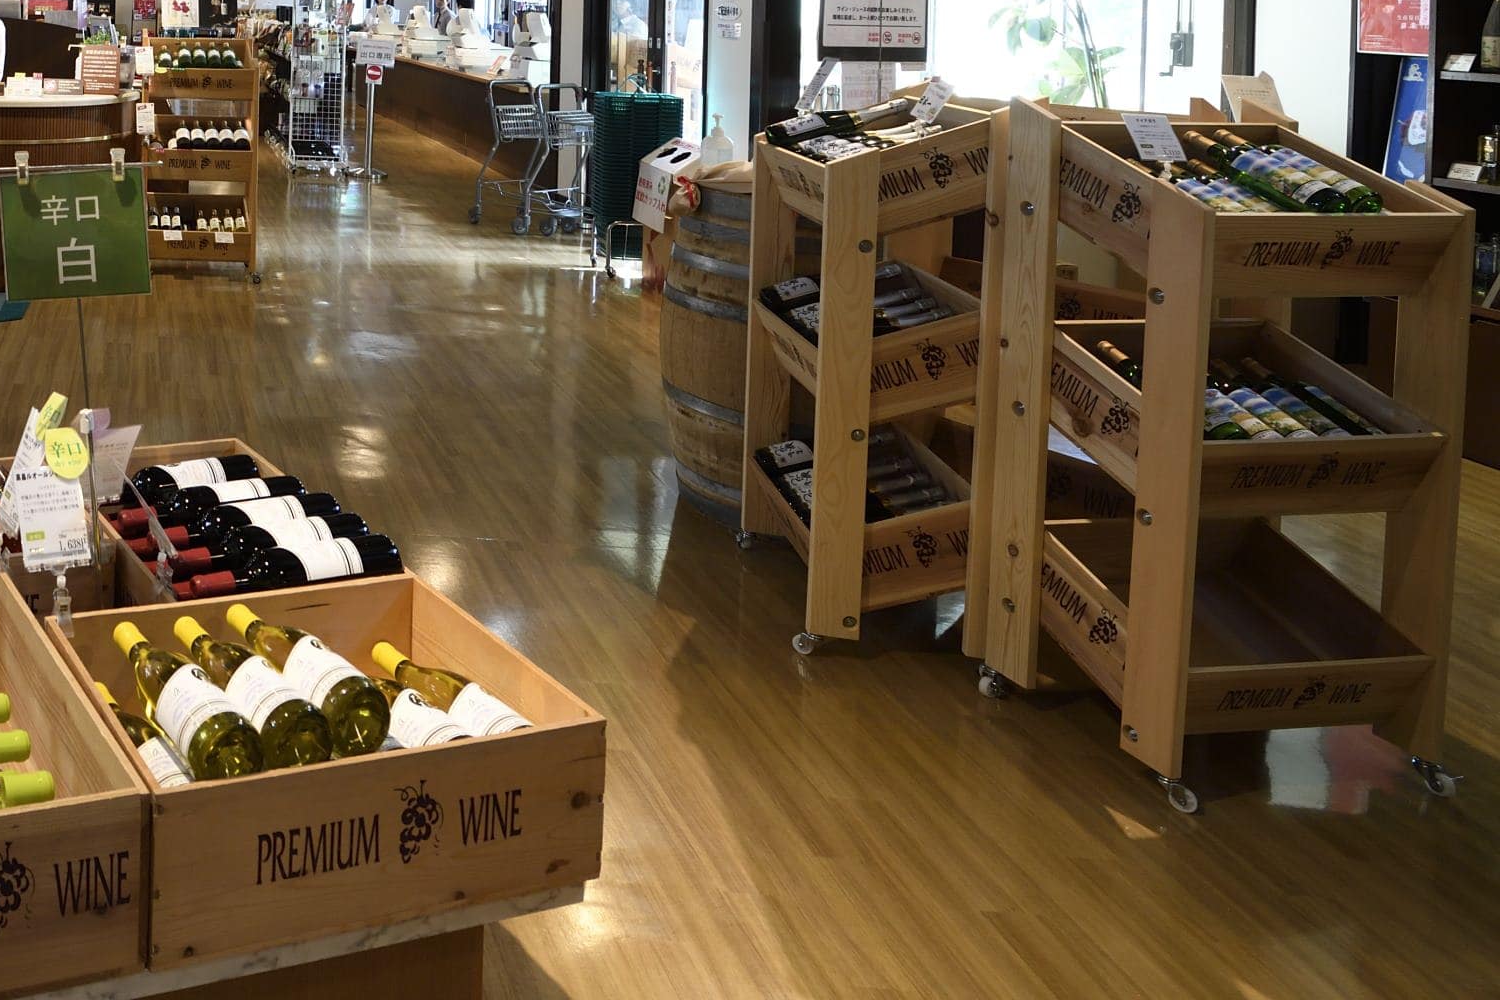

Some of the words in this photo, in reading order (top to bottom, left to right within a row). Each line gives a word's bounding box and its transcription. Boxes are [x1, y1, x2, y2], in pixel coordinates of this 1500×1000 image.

[216, 78, 234, 89] WINE
[214, 159, 232, 170] WINE
[40, 194, 100, 226] 辛口
[56, 237, 97, 285] 白
[1243, 241, 1320, 268] PREMIUM
[1355, 240, 1401, 266] WINE
[870, 358, 919, 392] MIUM
[1230, 464, 1306, 489] PREMIUM
[1340, 461, 1387, 486] WINE
[1216, 686, 1294, 712] PREMIUM
[1328, 682, 1373, 704] WINE
[256, 813, 381, 885] PREMIUM
[458, 788, 523, 846] WINE
[53, 850, 132, 917] WINE
